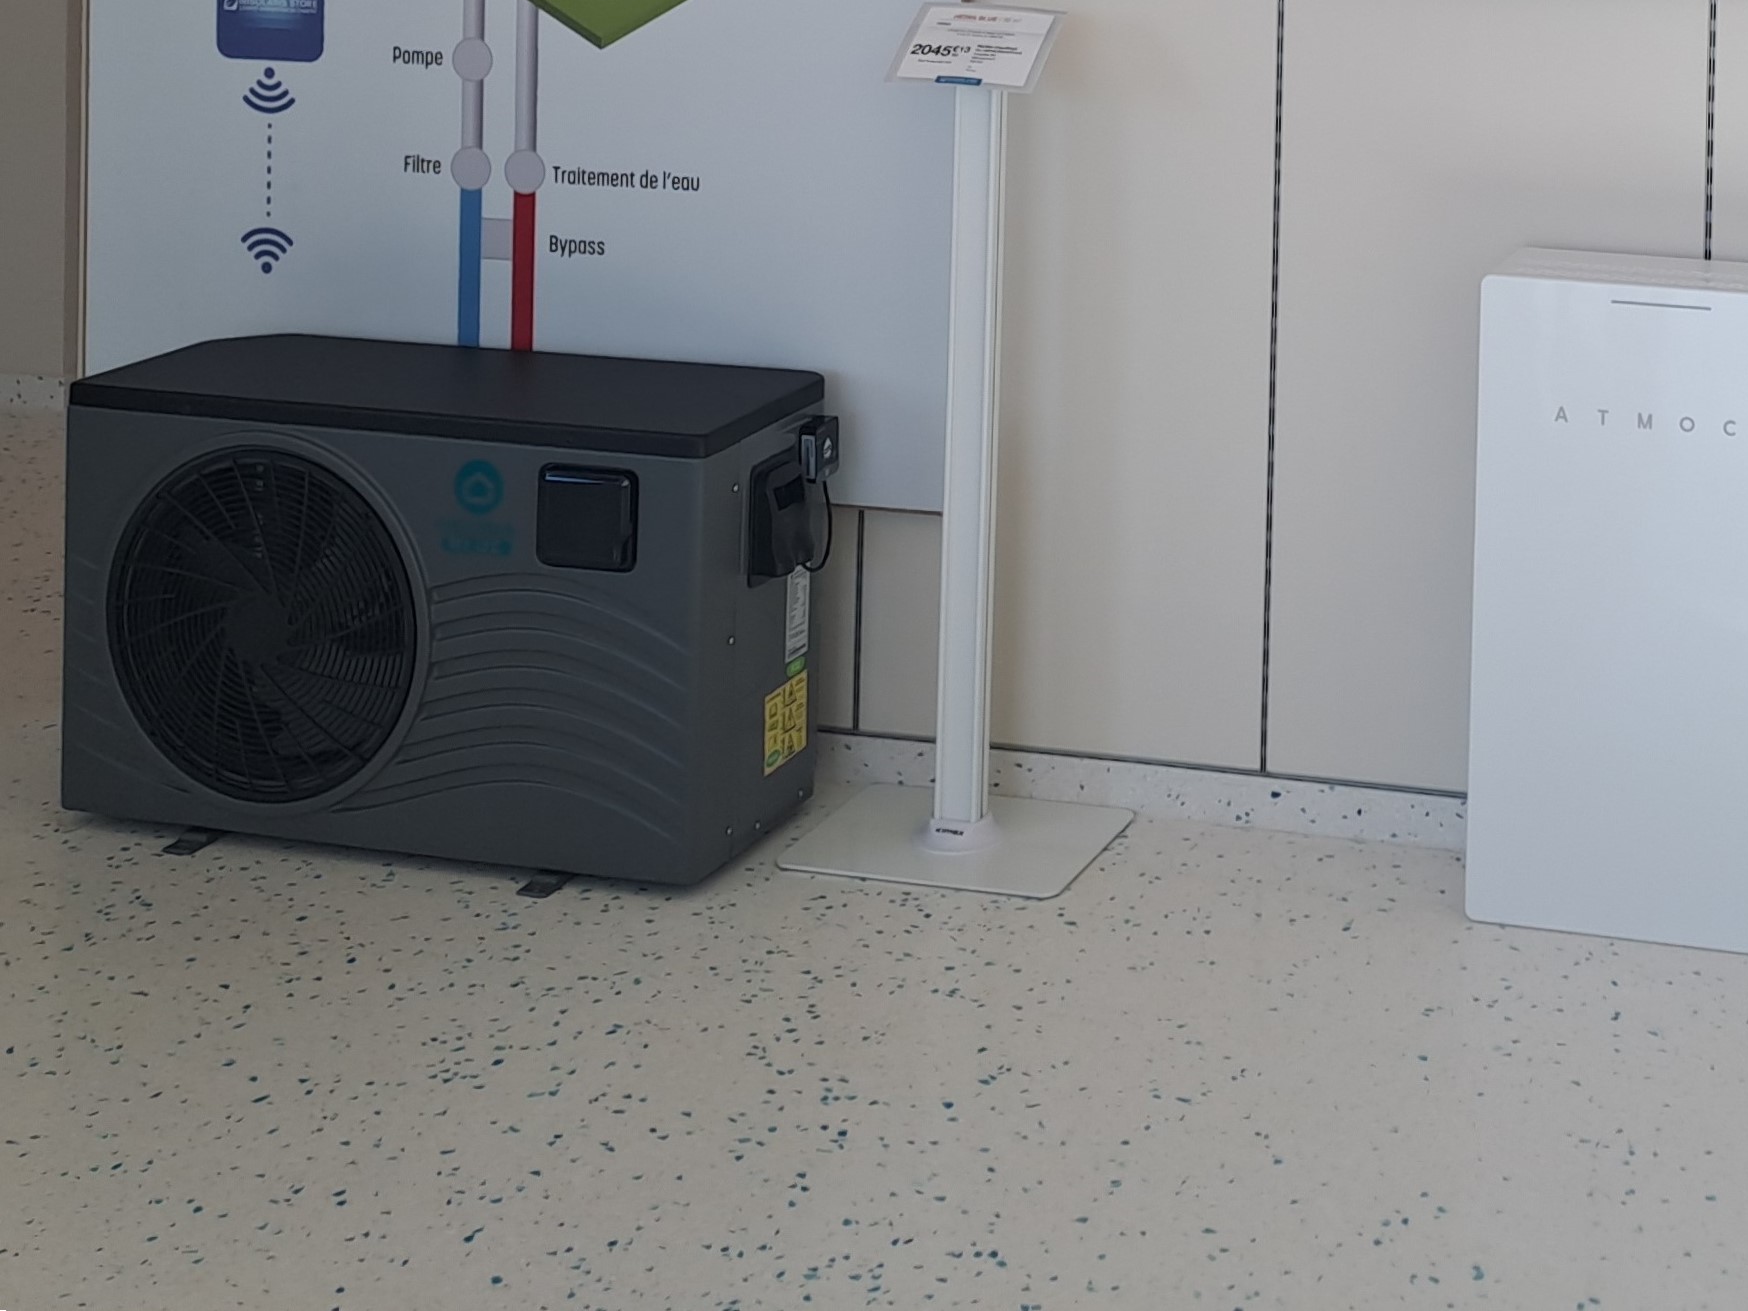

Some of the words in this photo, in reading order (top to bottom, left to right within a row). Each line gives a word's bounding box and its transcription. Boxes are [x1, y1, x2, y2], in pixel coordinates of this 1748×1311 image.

[392, 46, 443, 69] Pompe
[404, 155, 441, 174] Filtre
[553, 166, 635, 188] Traitement
[639, 169, 658, 189] de
[662, 172, 700, 191] l'eau
[549, 235, 605, 257] Bypass
